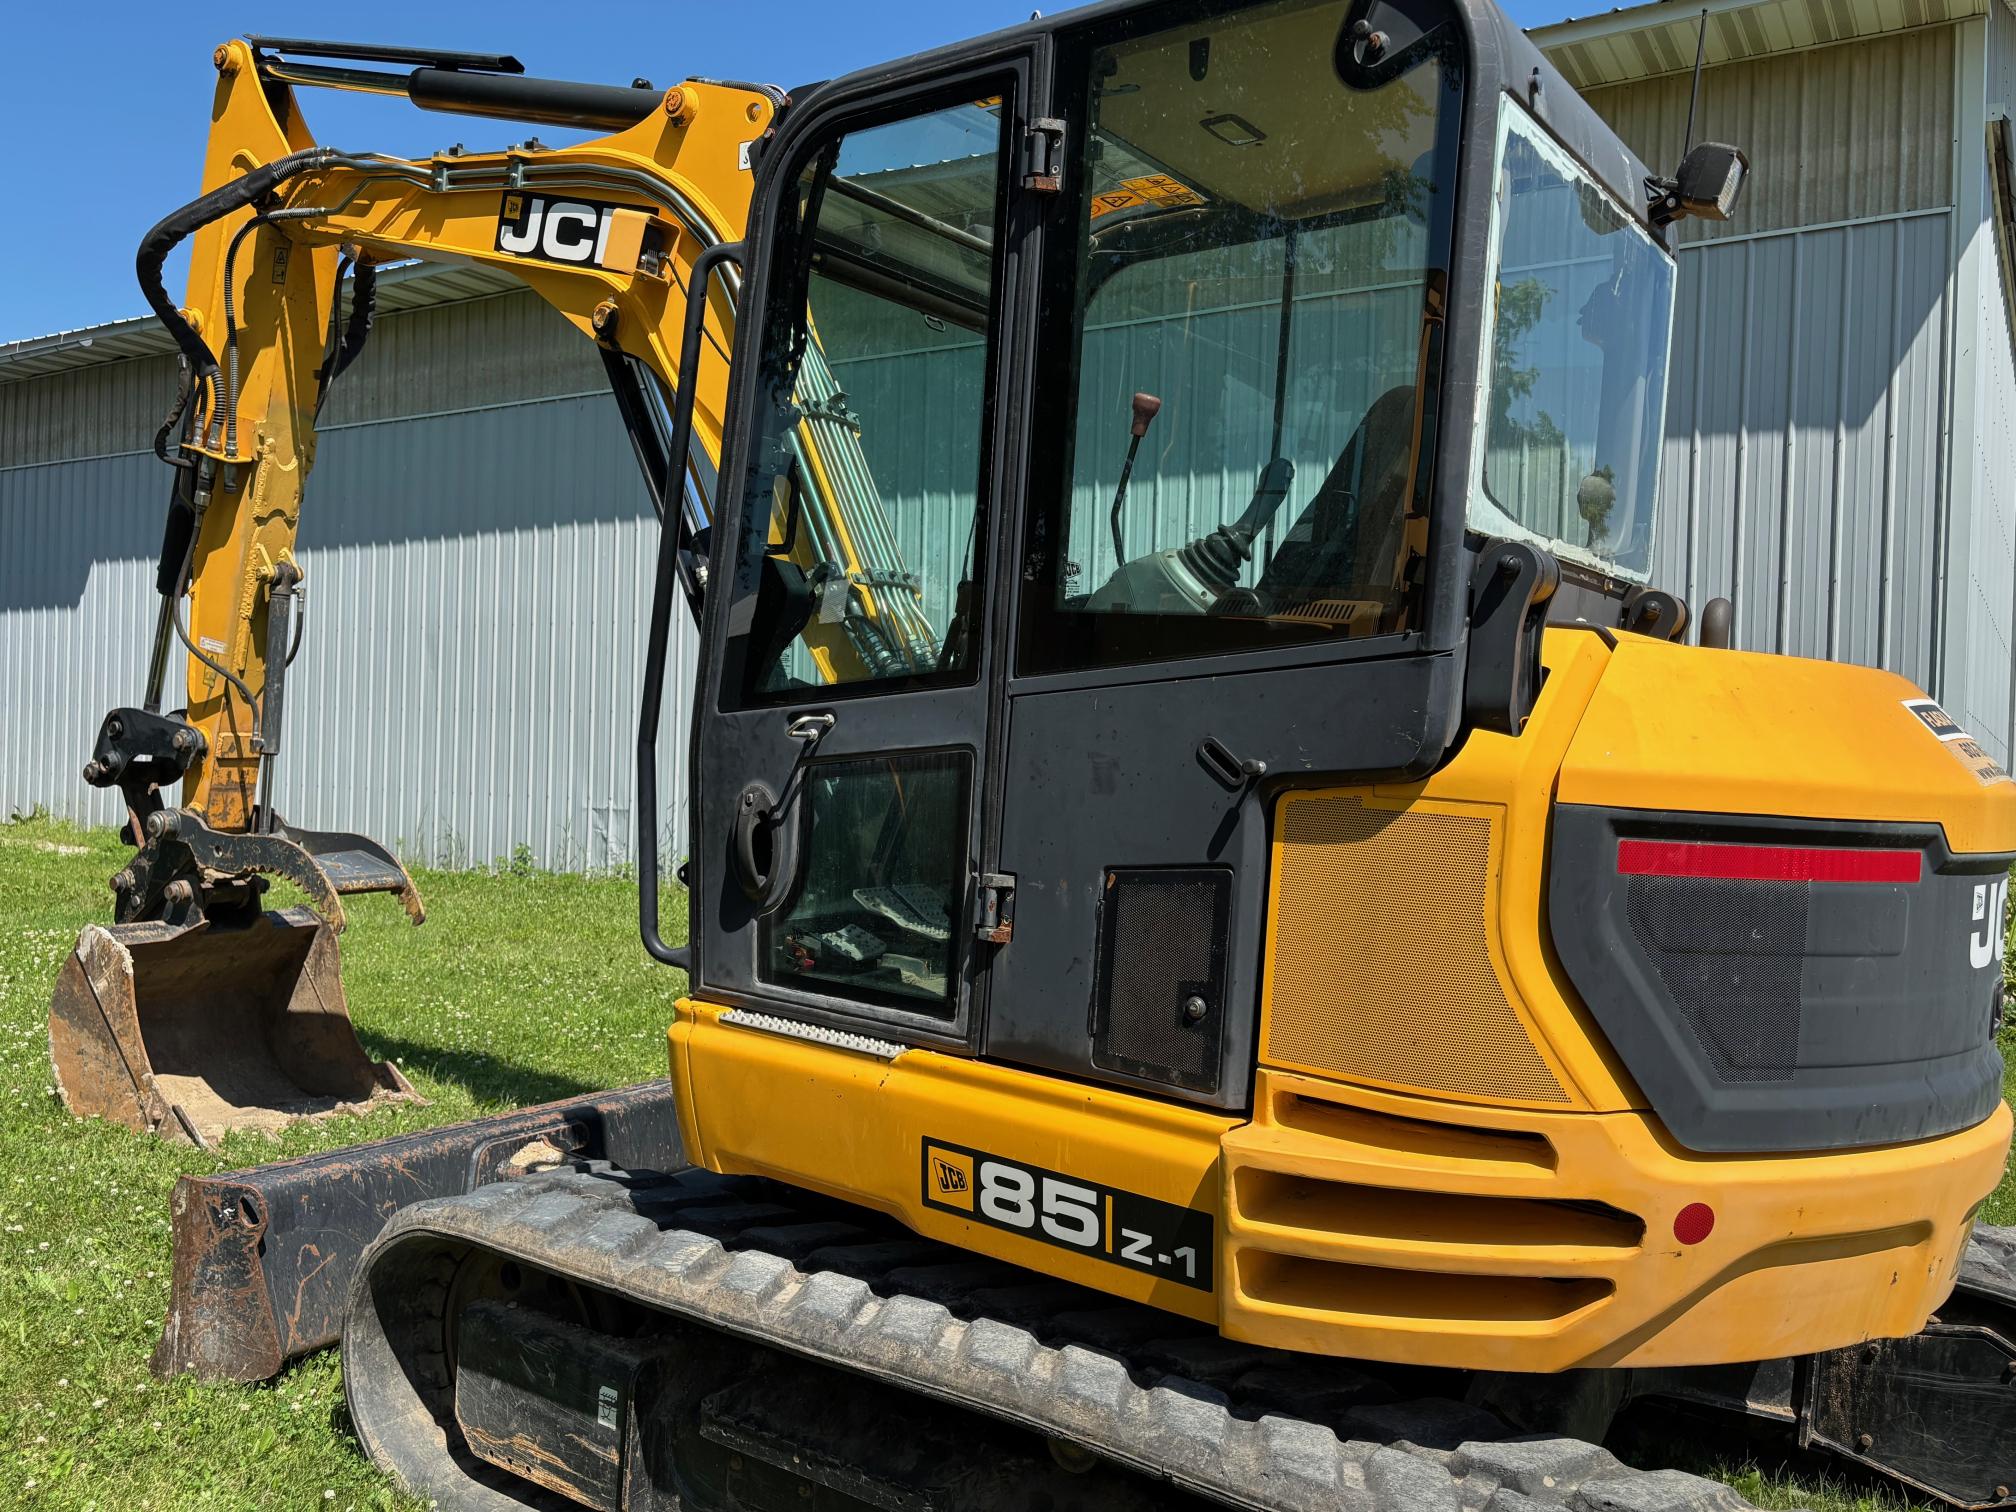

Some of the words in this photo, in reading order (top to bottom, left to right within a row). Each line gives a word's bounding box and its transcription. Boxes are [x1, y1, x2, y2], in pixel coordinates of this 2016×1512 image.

[500, 198, 613, 264] JC
[939, 1162, 966, 1190] JCB
[980, 1161, 1099, 1247] 85
